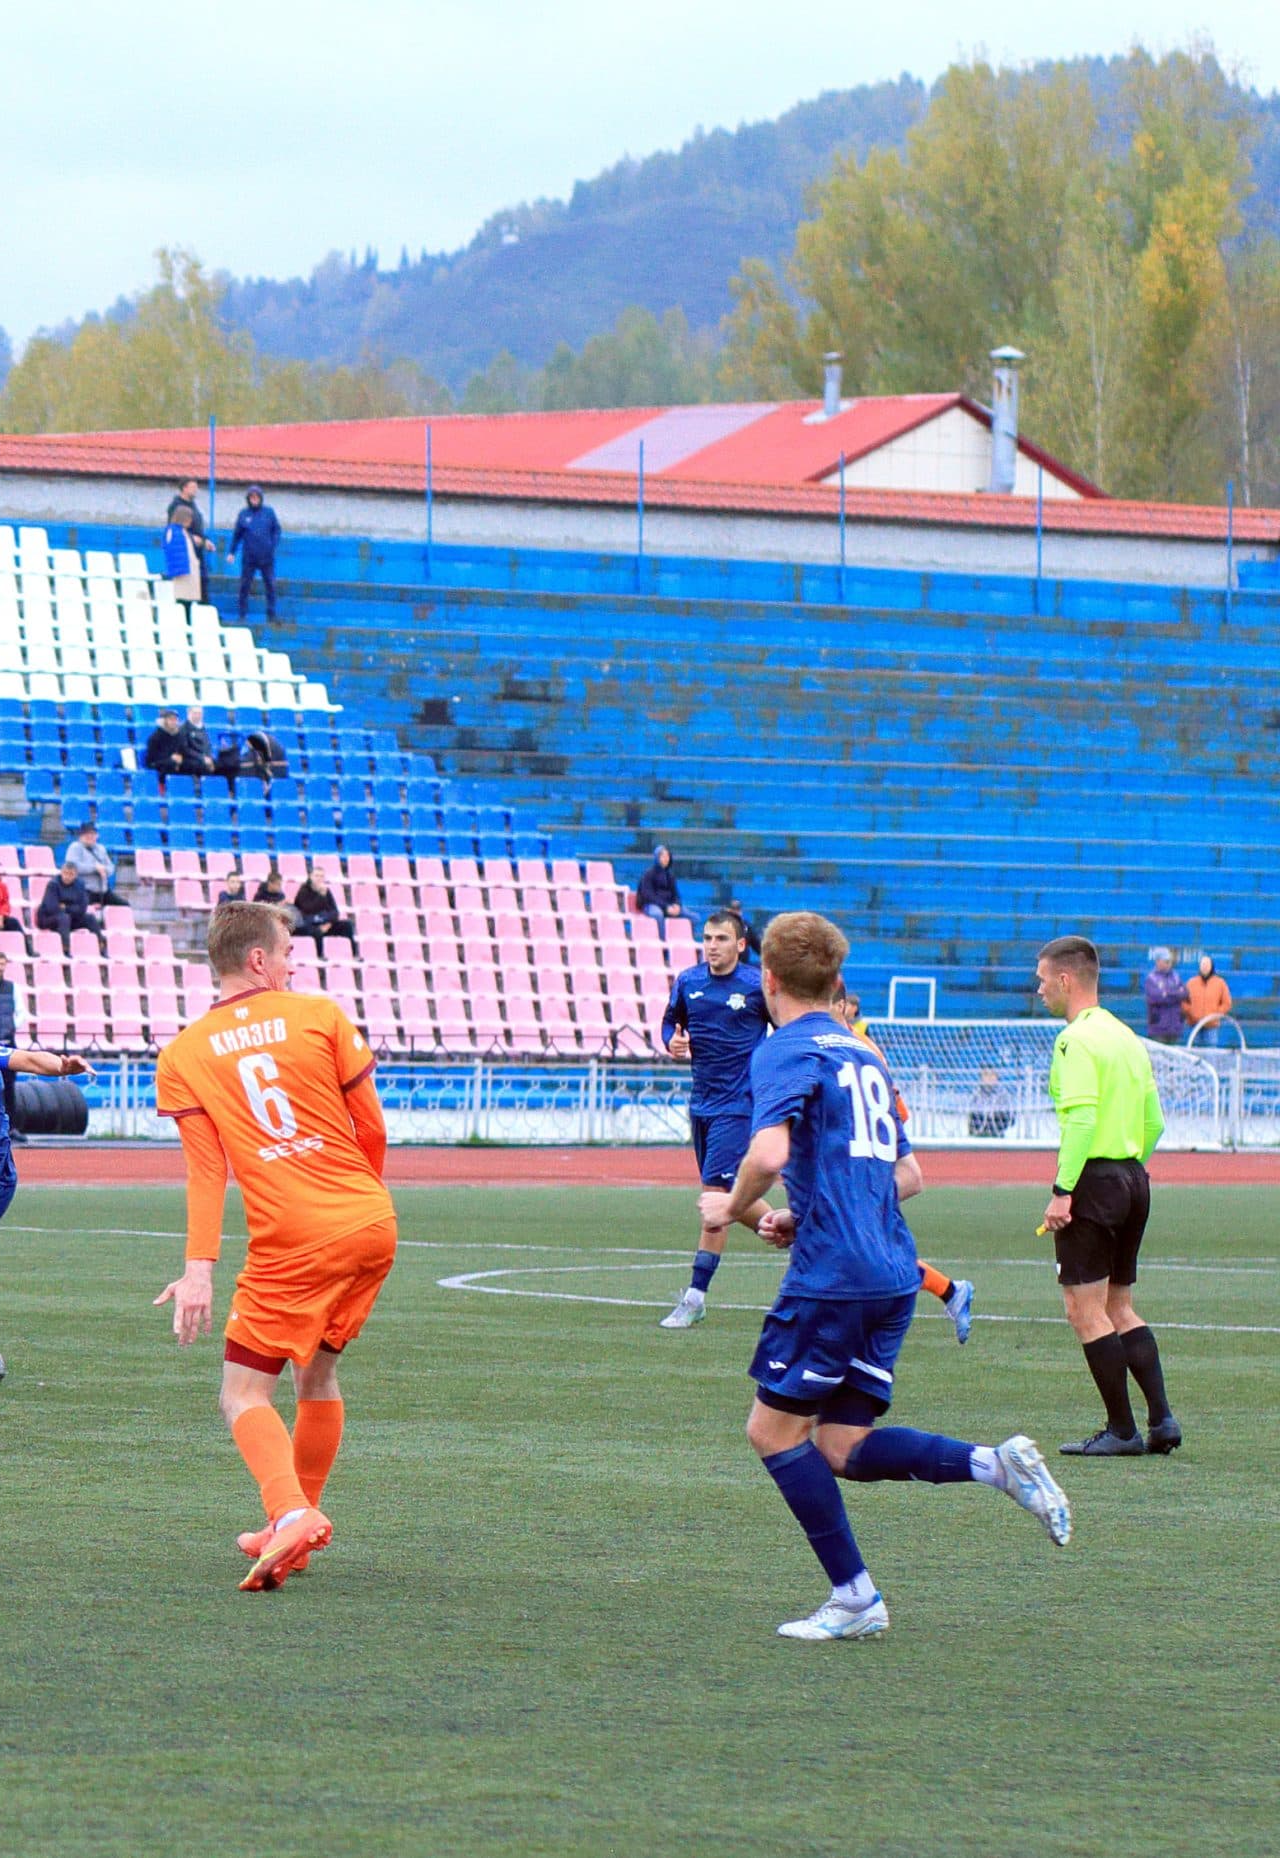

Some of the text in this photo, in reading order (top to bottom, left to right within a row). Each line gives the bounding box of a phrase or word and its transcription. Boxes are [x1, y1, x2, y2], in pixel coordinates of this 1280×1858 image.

[209, 1017, 287, 1057] КНЯЗЕВ
[237, 1052, 298, 1139] 6
[837, 1061, 898, 1163] 18
